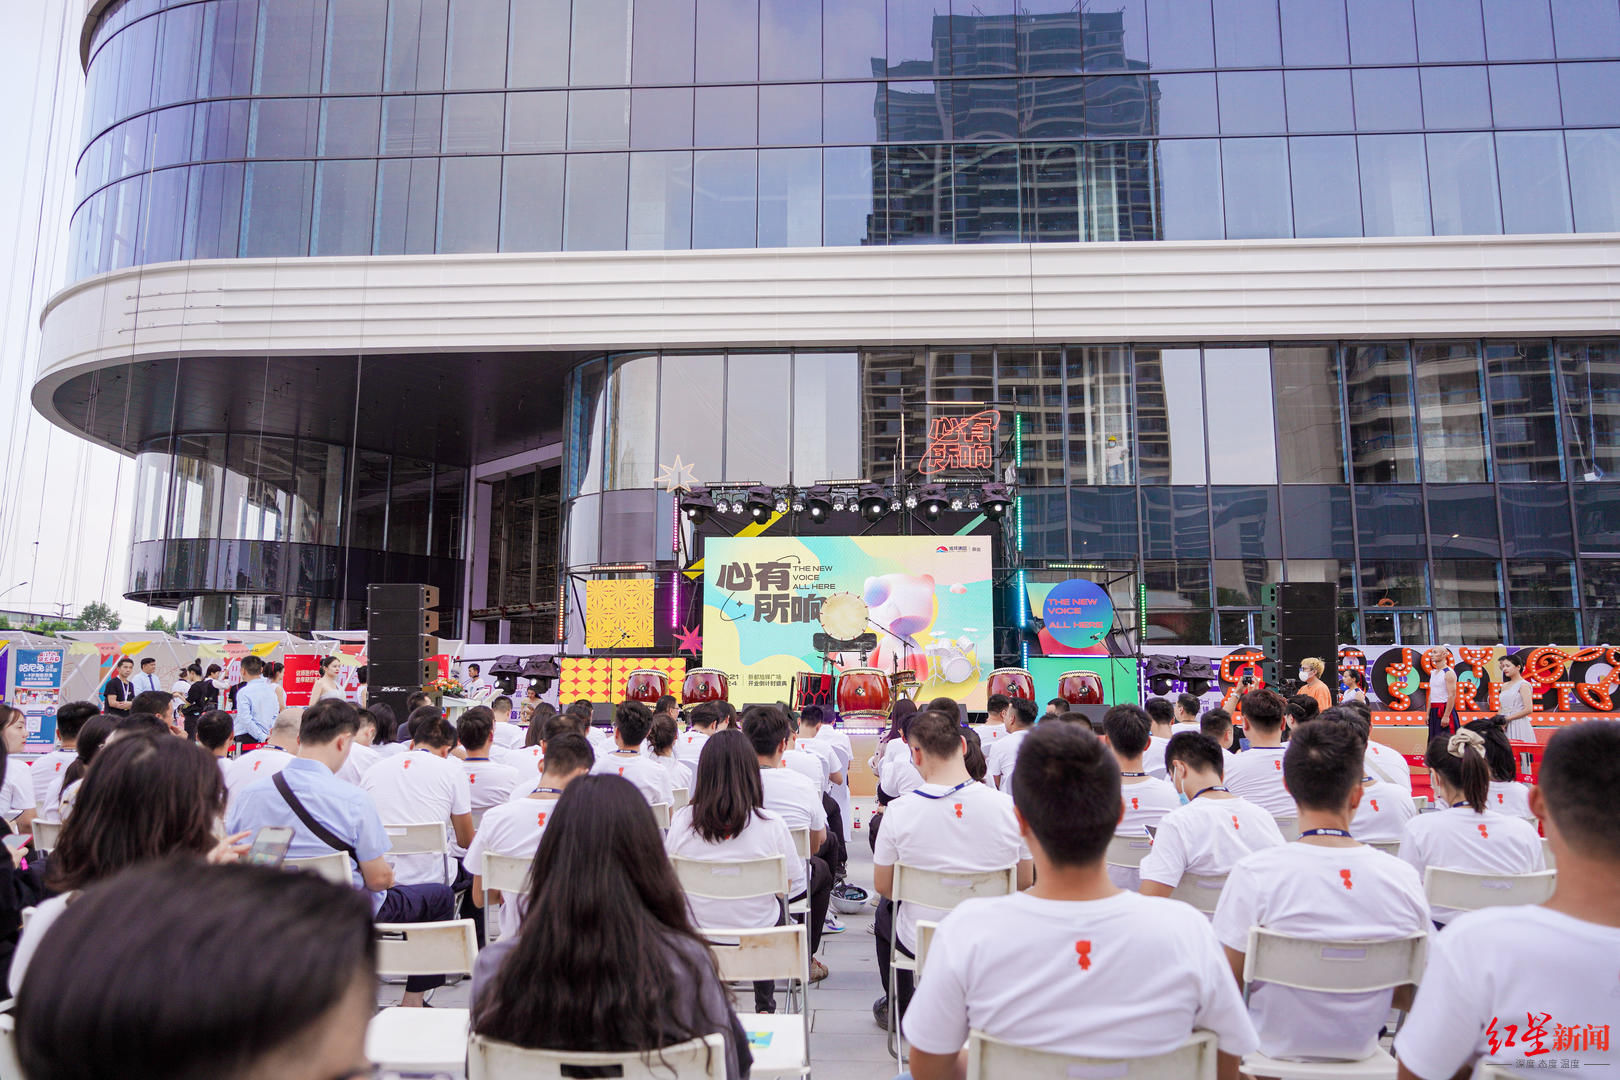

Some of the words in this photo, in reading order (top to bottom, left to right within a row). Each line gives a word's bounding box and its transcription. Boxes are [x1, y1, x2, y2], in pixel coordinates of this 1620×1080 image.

[928, 416, 992, 442] 心有
[928, 443, 992, 469] 所响
[715, 562, 791, 591] 心有
[752, 593, 828, 623] 所响
[1048, 598, 1070, 606] THE
[1072, 598, 1098, 606] NEW
[1048, 607, 1082, 615] VOICE
[1049, 621, 1071, 629] ALL
[1073, 621, 1104, 629] HERE
